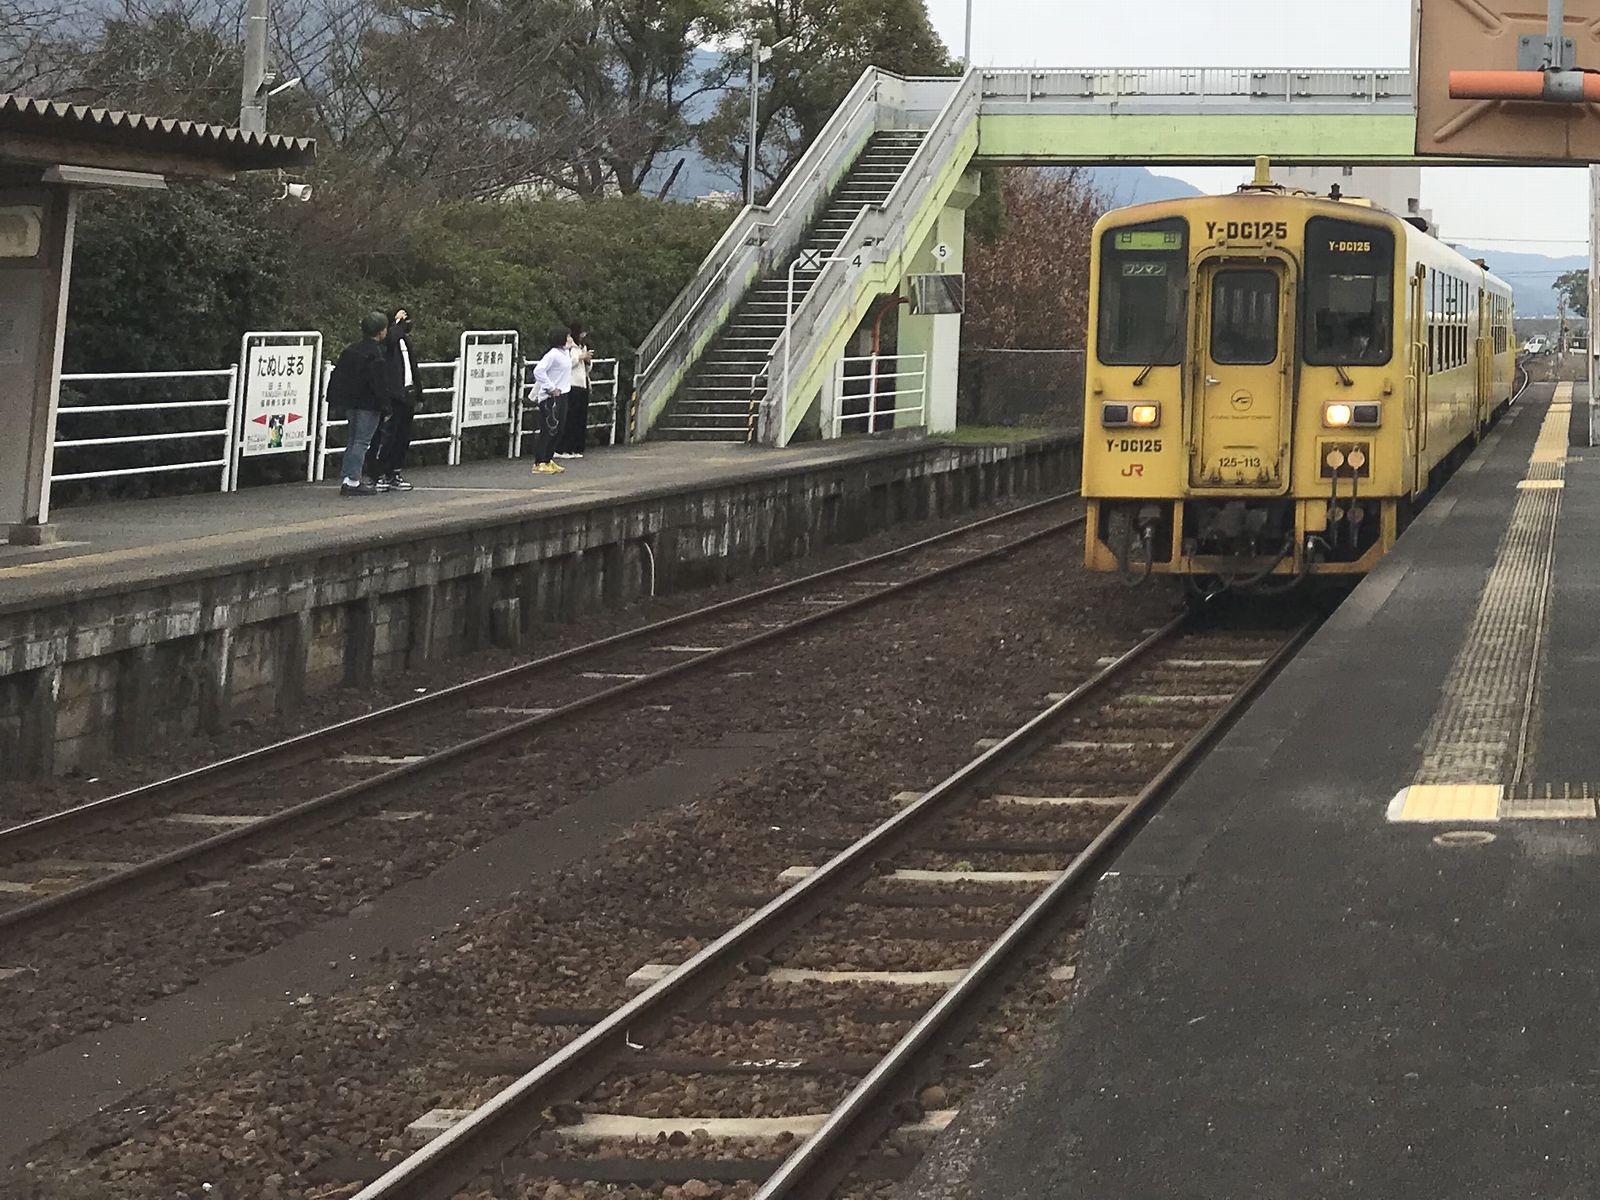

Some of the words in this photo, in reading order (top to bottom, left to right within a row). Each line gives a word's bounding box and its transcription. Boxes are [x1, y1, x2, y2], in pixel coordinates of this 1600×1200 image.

[1205, 221, 1288, 240] Y-DC125
[939, 245, 947, 257] 5
[1328, 240, 1371, 252] Y-DC125
[852, 254, 862, 268] 4
[1124, 263, 1164, 275] ワンマン
[476, 350, 504, 365] 名所案内
[257, 354, 305, 377] たぬしまる
[1106, 439, 1162, 453] Y-DC125
[1218, 457, 1261, 468] 125-113
[1121, 463, 1144, 477] JR
